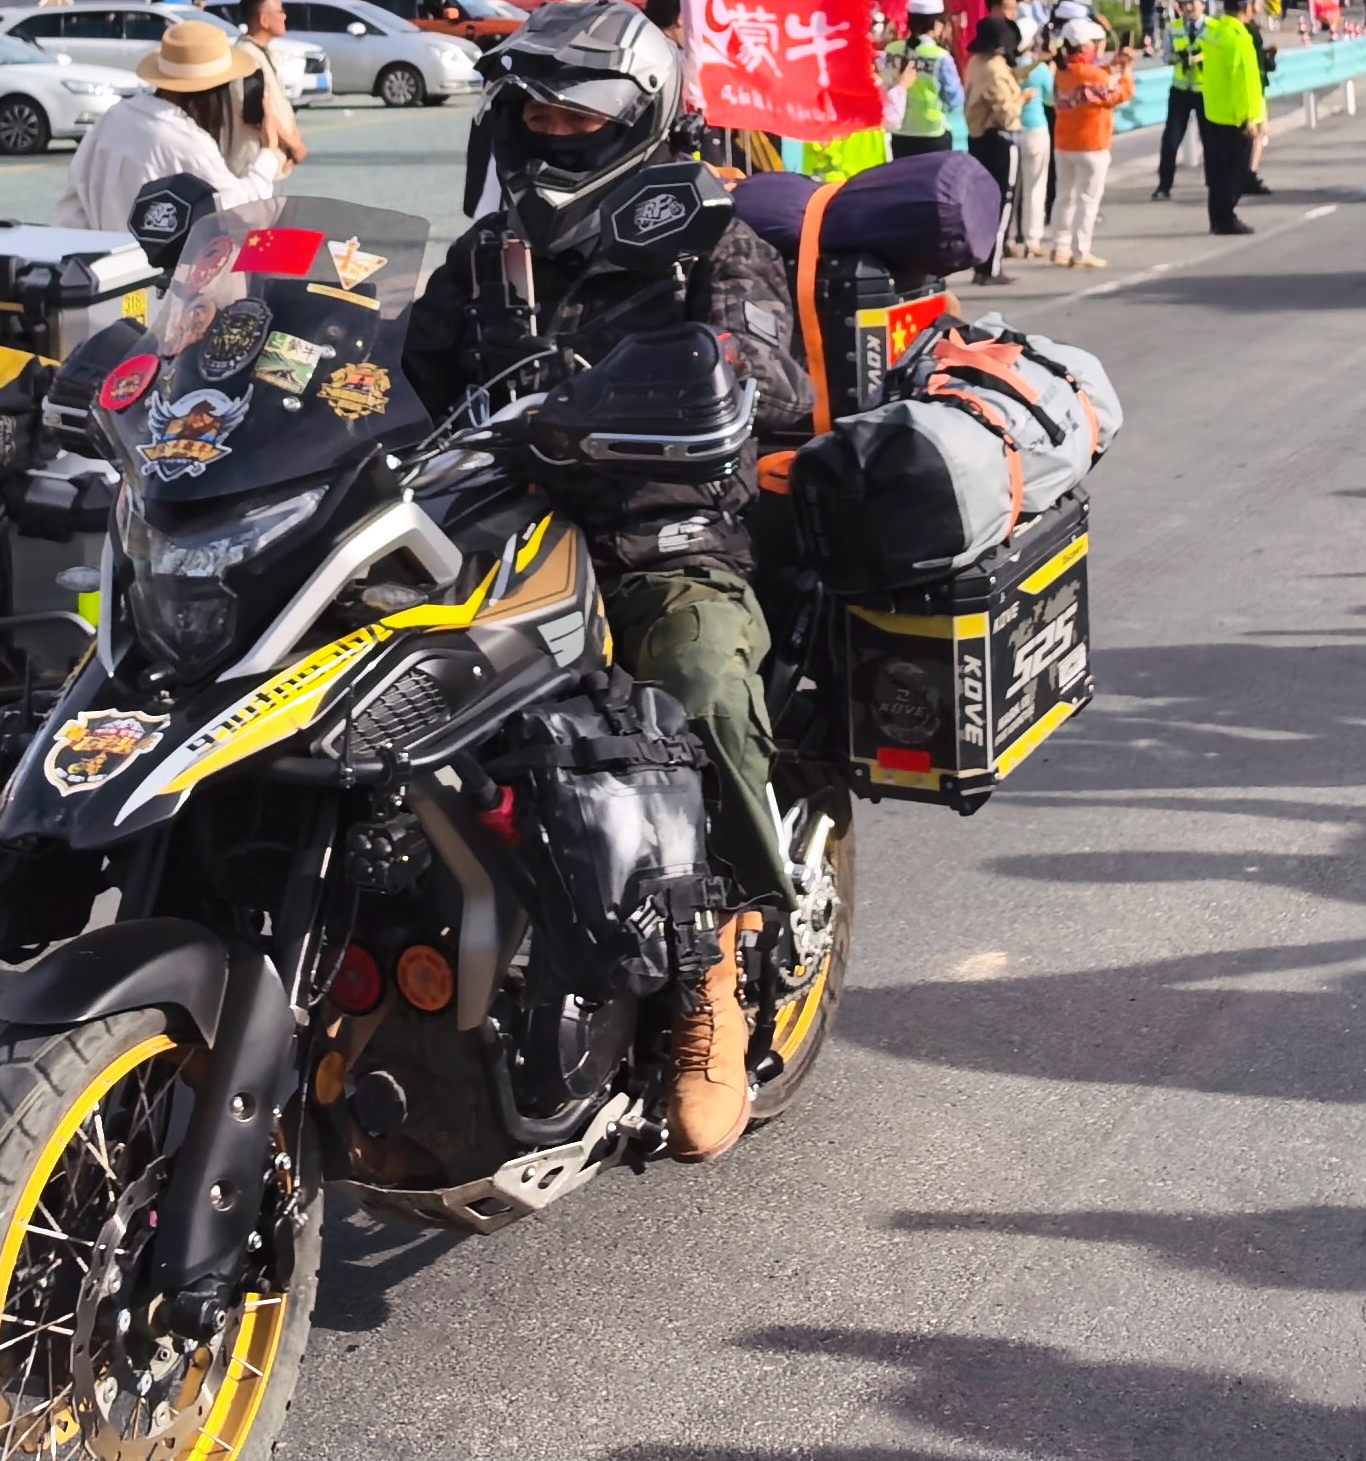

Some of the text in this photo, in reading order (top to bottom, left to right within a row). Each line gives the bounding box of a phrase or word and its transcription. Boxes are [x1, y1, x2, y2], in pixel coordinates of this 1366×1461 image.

[727, 1, 851, 88] 蒙牛
[1004, 601, 1078, 701] 525
[963, 654, 984, 747] KOVE
